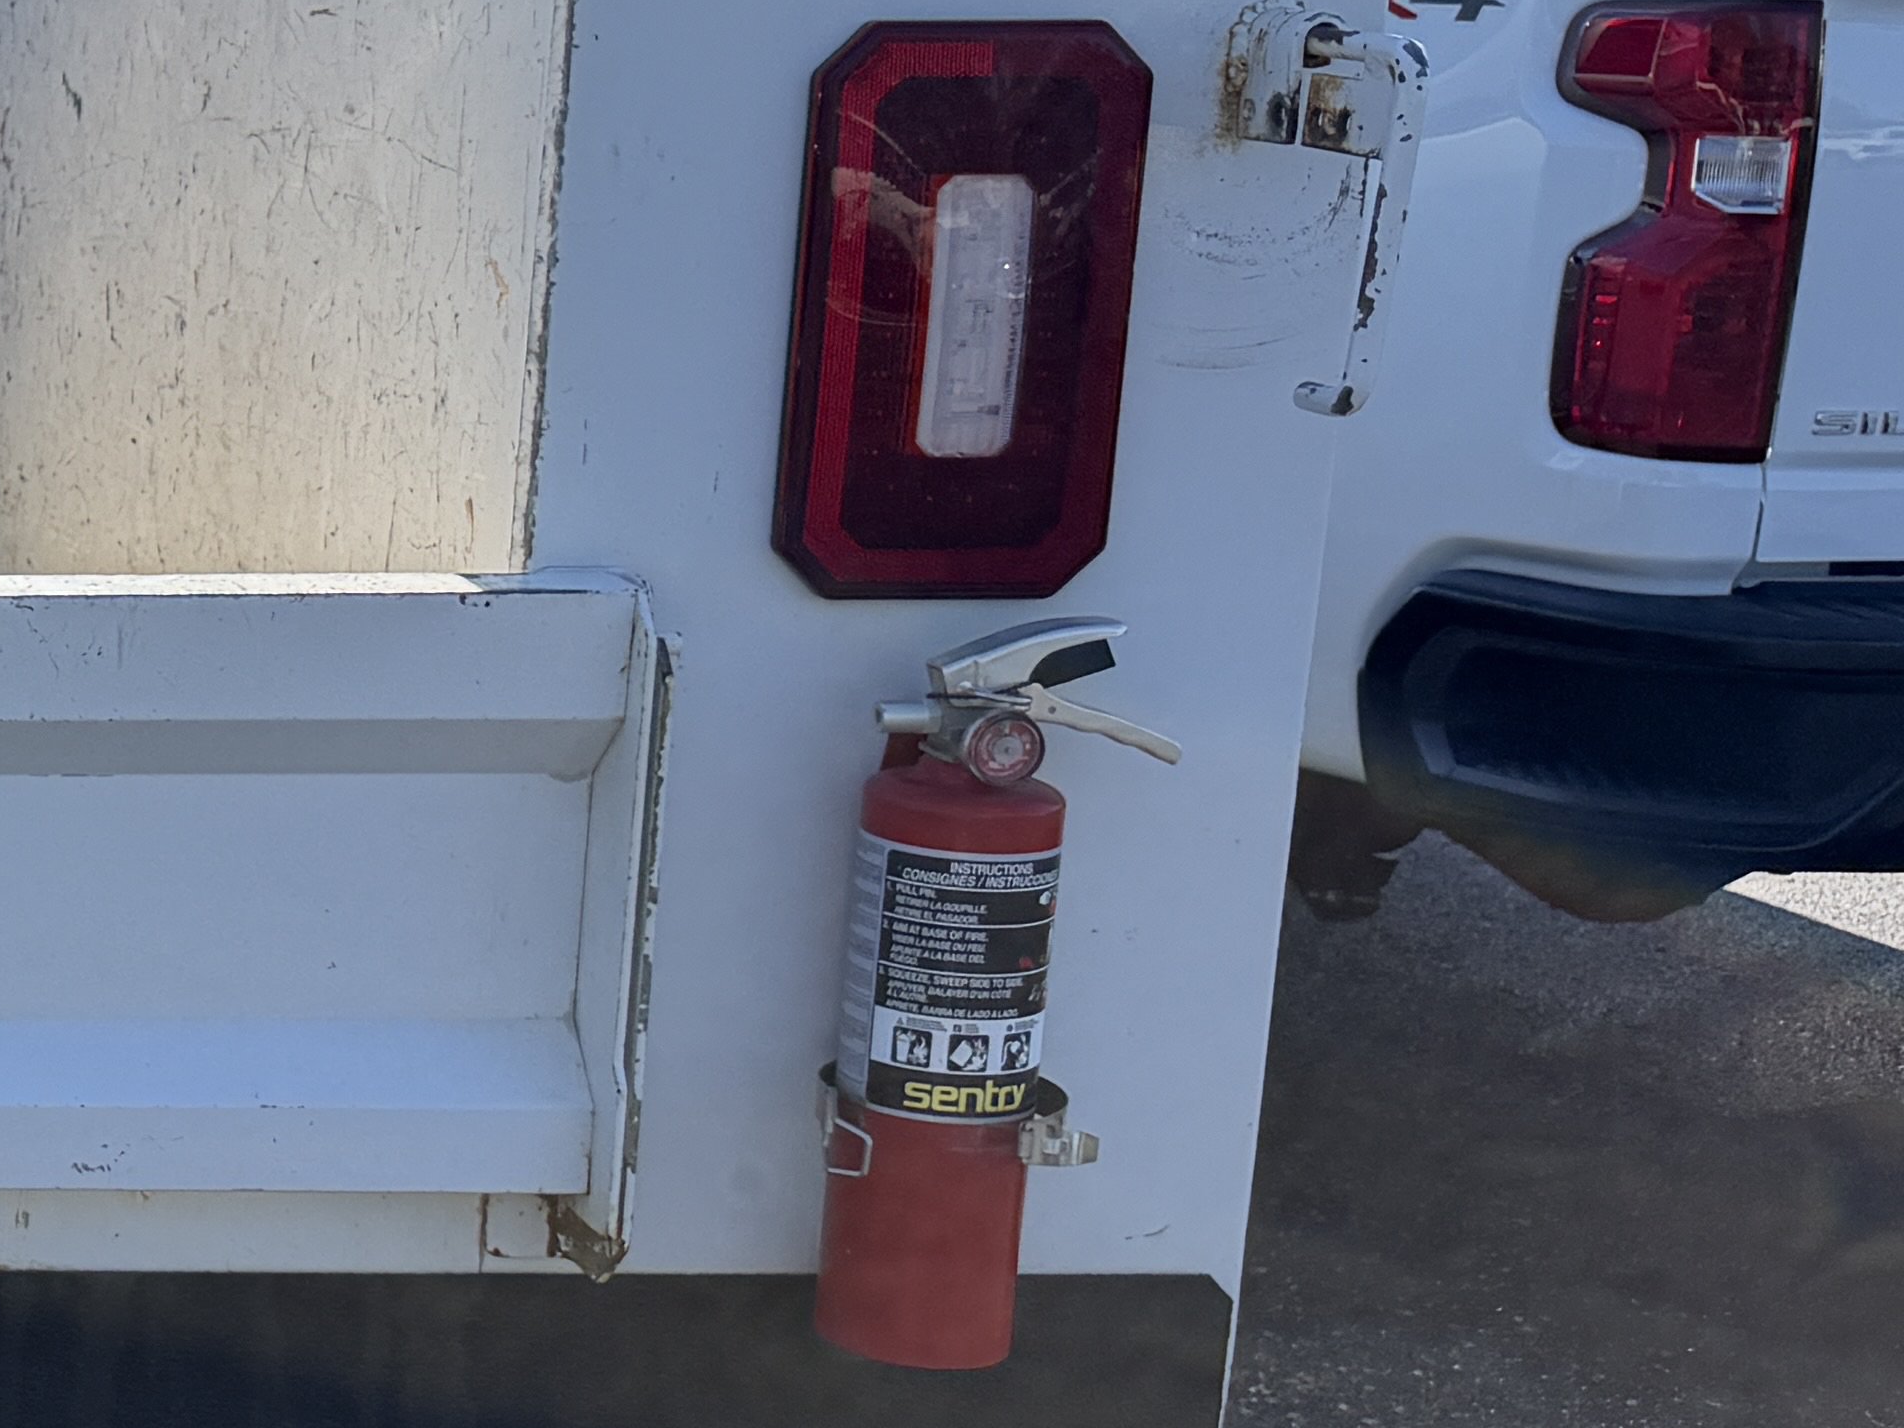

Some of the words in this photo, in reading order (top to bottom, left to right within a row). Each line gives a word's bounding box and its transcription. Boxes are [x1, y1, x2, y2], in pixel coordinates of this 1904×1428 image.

[950, 862, 1034, 875] INSTRUCTIONS
[902, 867, 977, 887] CONSIGNES
[896, 884, 918, 897] PULL
[903, 1080, 1026, 1113] sentry
